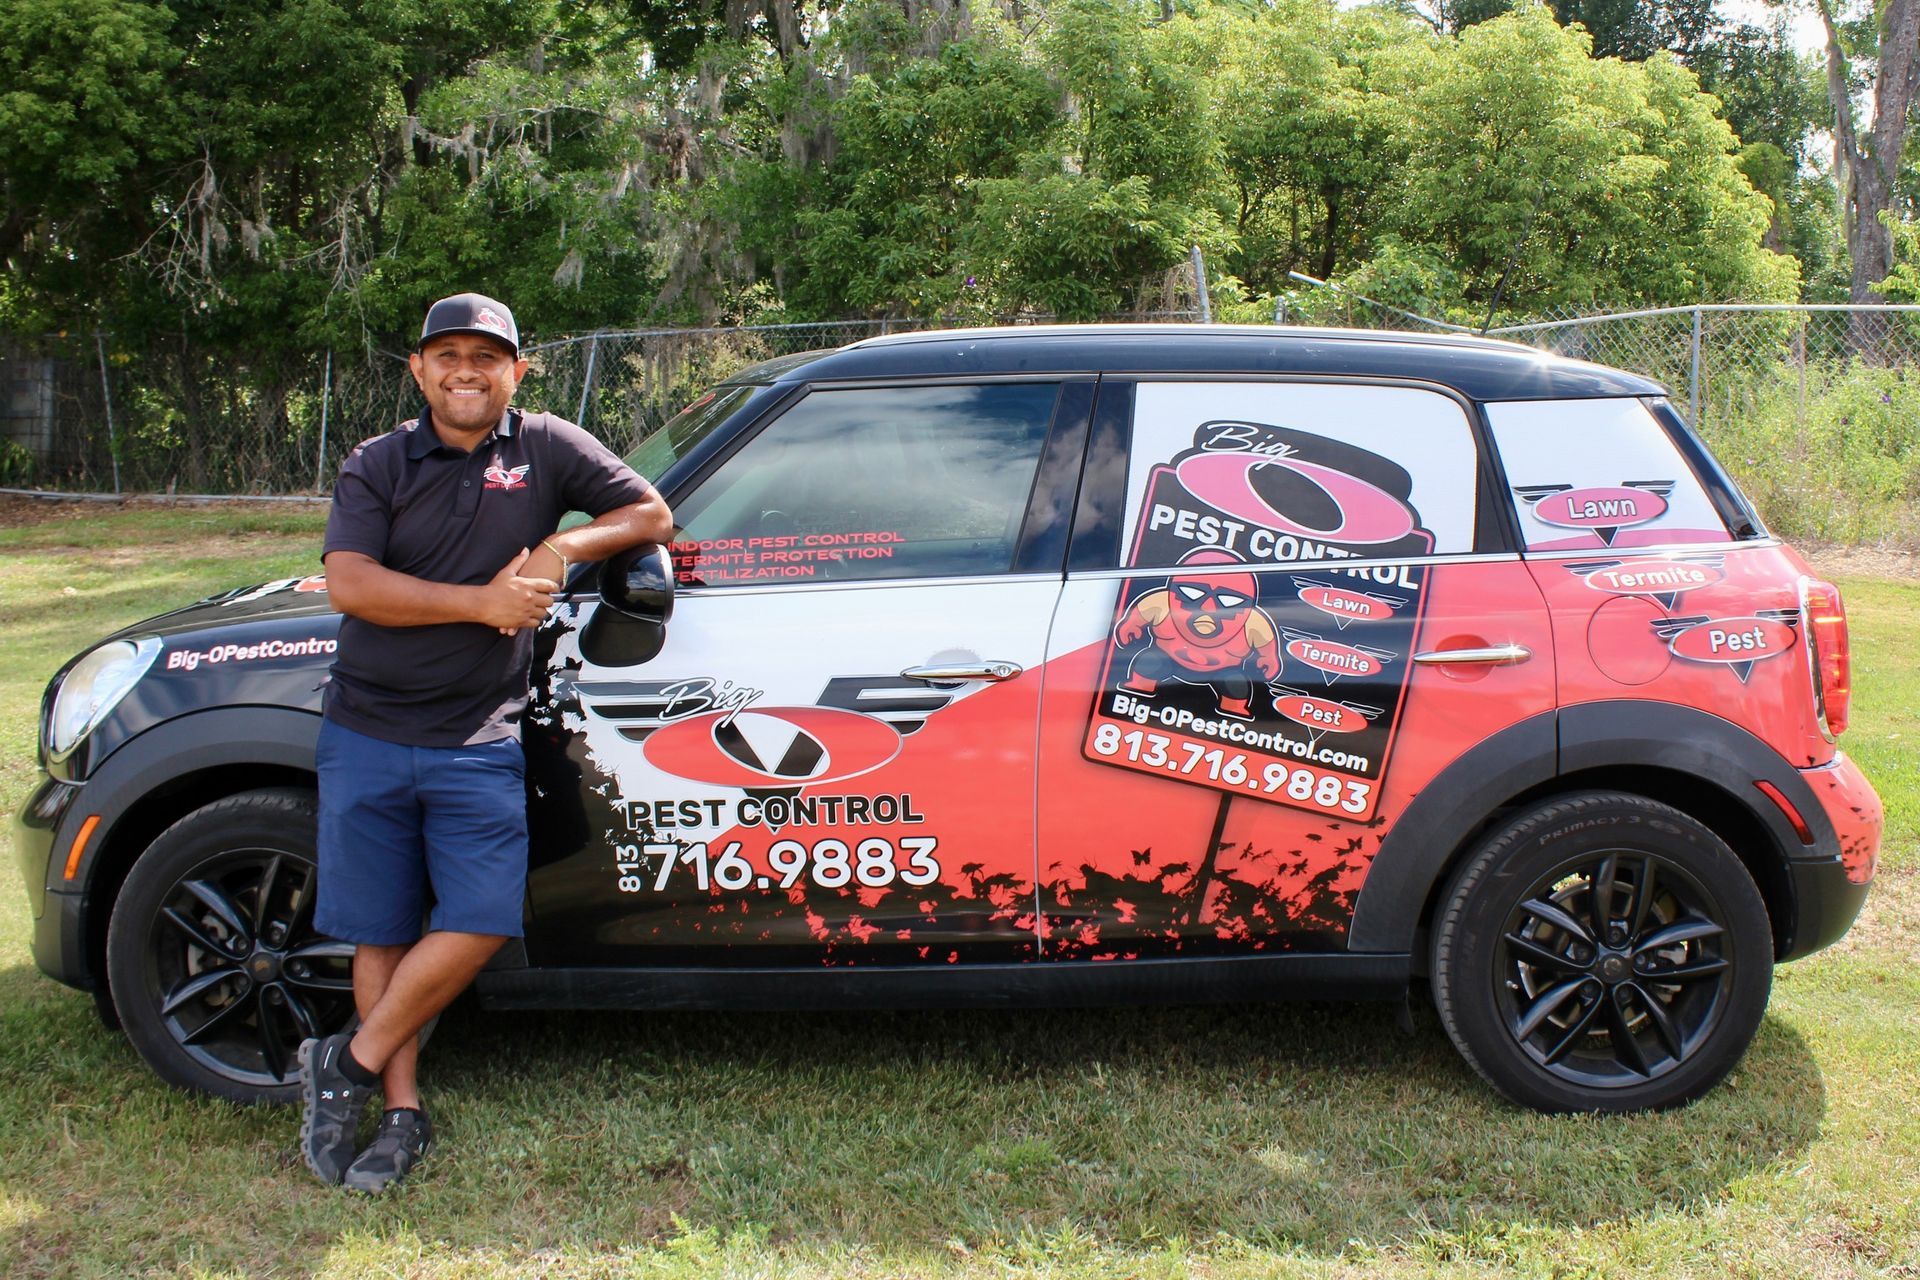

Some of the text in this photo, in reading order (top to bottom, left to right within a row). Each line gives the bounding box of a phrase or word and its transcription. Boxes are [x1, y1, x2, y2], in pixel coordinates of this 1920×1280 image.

[1201, 423, 1299, 470] Big
[1567, 497, 1636, 521] Lawn
[749, 536, 799, 548] PEST
[804, 531, 905, 546] CONTROL
[1149, 504, 1245, 549] PEST
[671, 547, 893, 567] TERMITE PROTECTION
[1604, 566, 1706, 589] Termite
[1321, 592, 1371, 616] Lawn
[168, 638, 337, 670] Big-OPestContro
[1709, 626, 1767, 653] Pest
[1301, 644, 1370, 672] Termite
[658, 677, 764, 728] Big
[1300, 702, 1342, 726] Pest
[1111, 694, 1369, 772] Big-OPestControl.com
[1093, 724, 1371, 814] 813.716.9883
[627, 793, 925, 830] PEST CONTROL
[615, 844, 641, 893] 813
[643, 837, 941, 892] 716.9883
